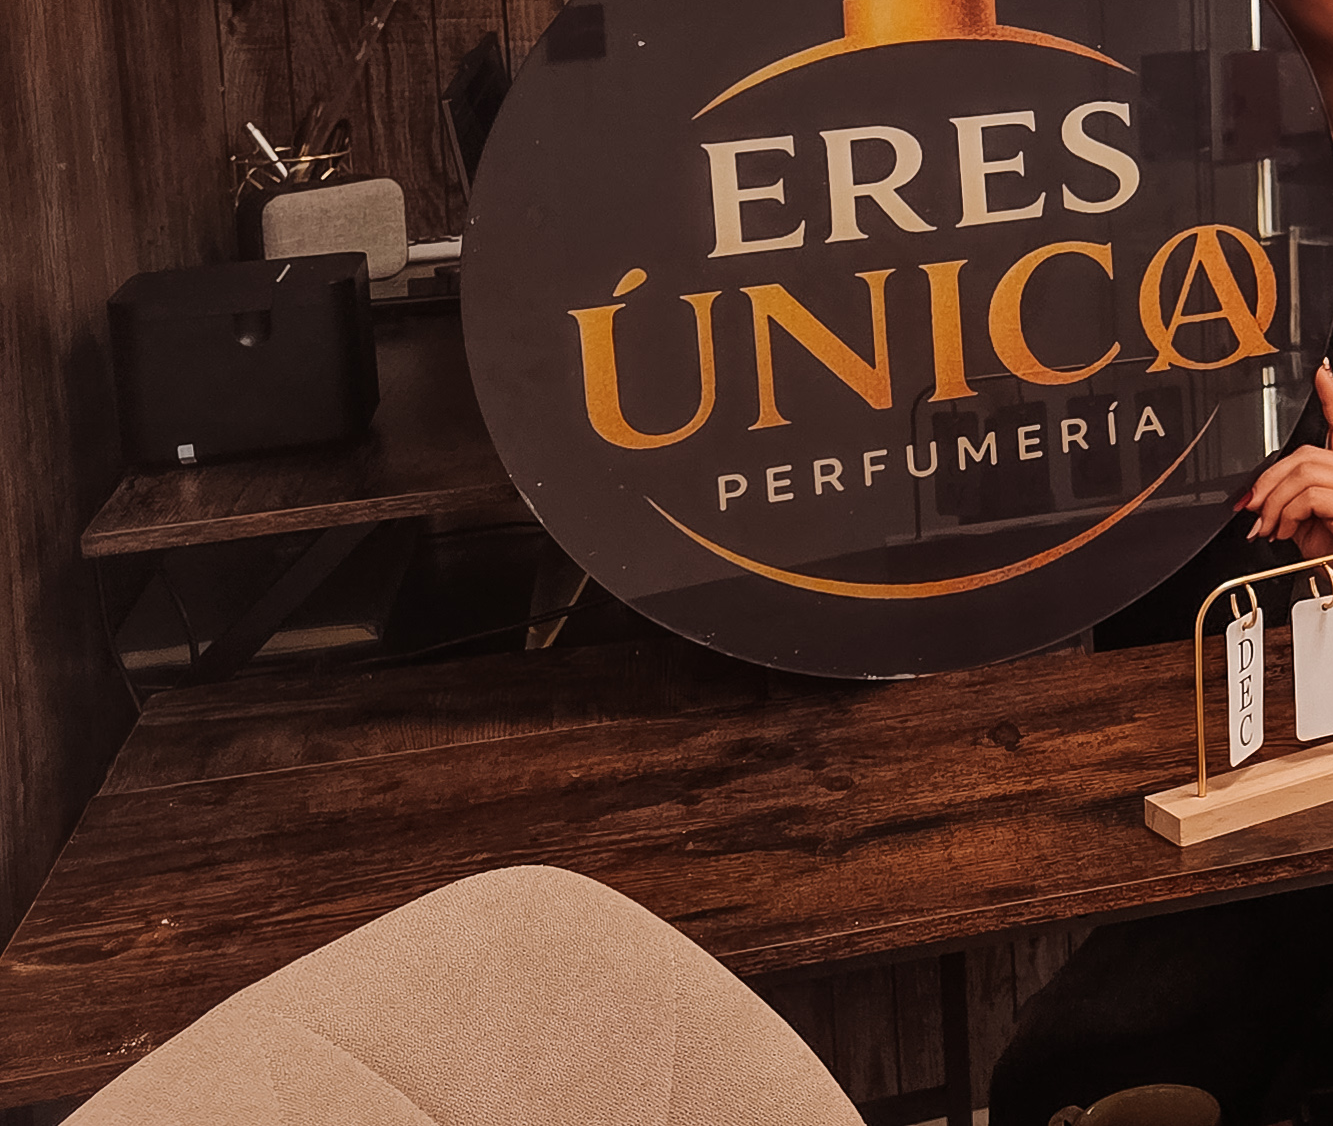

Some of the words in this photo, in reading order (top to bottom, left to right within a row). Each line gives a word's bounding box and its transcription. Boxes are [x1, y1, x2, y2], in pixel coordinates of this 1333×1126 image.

[700, 100, 1142, 260] ERES
[566, 223, 1281, 451] ÚNICA
[717, 401, 1167, 512] PERFUMERÍA
[1237, 637, 1255, 748] DEC
